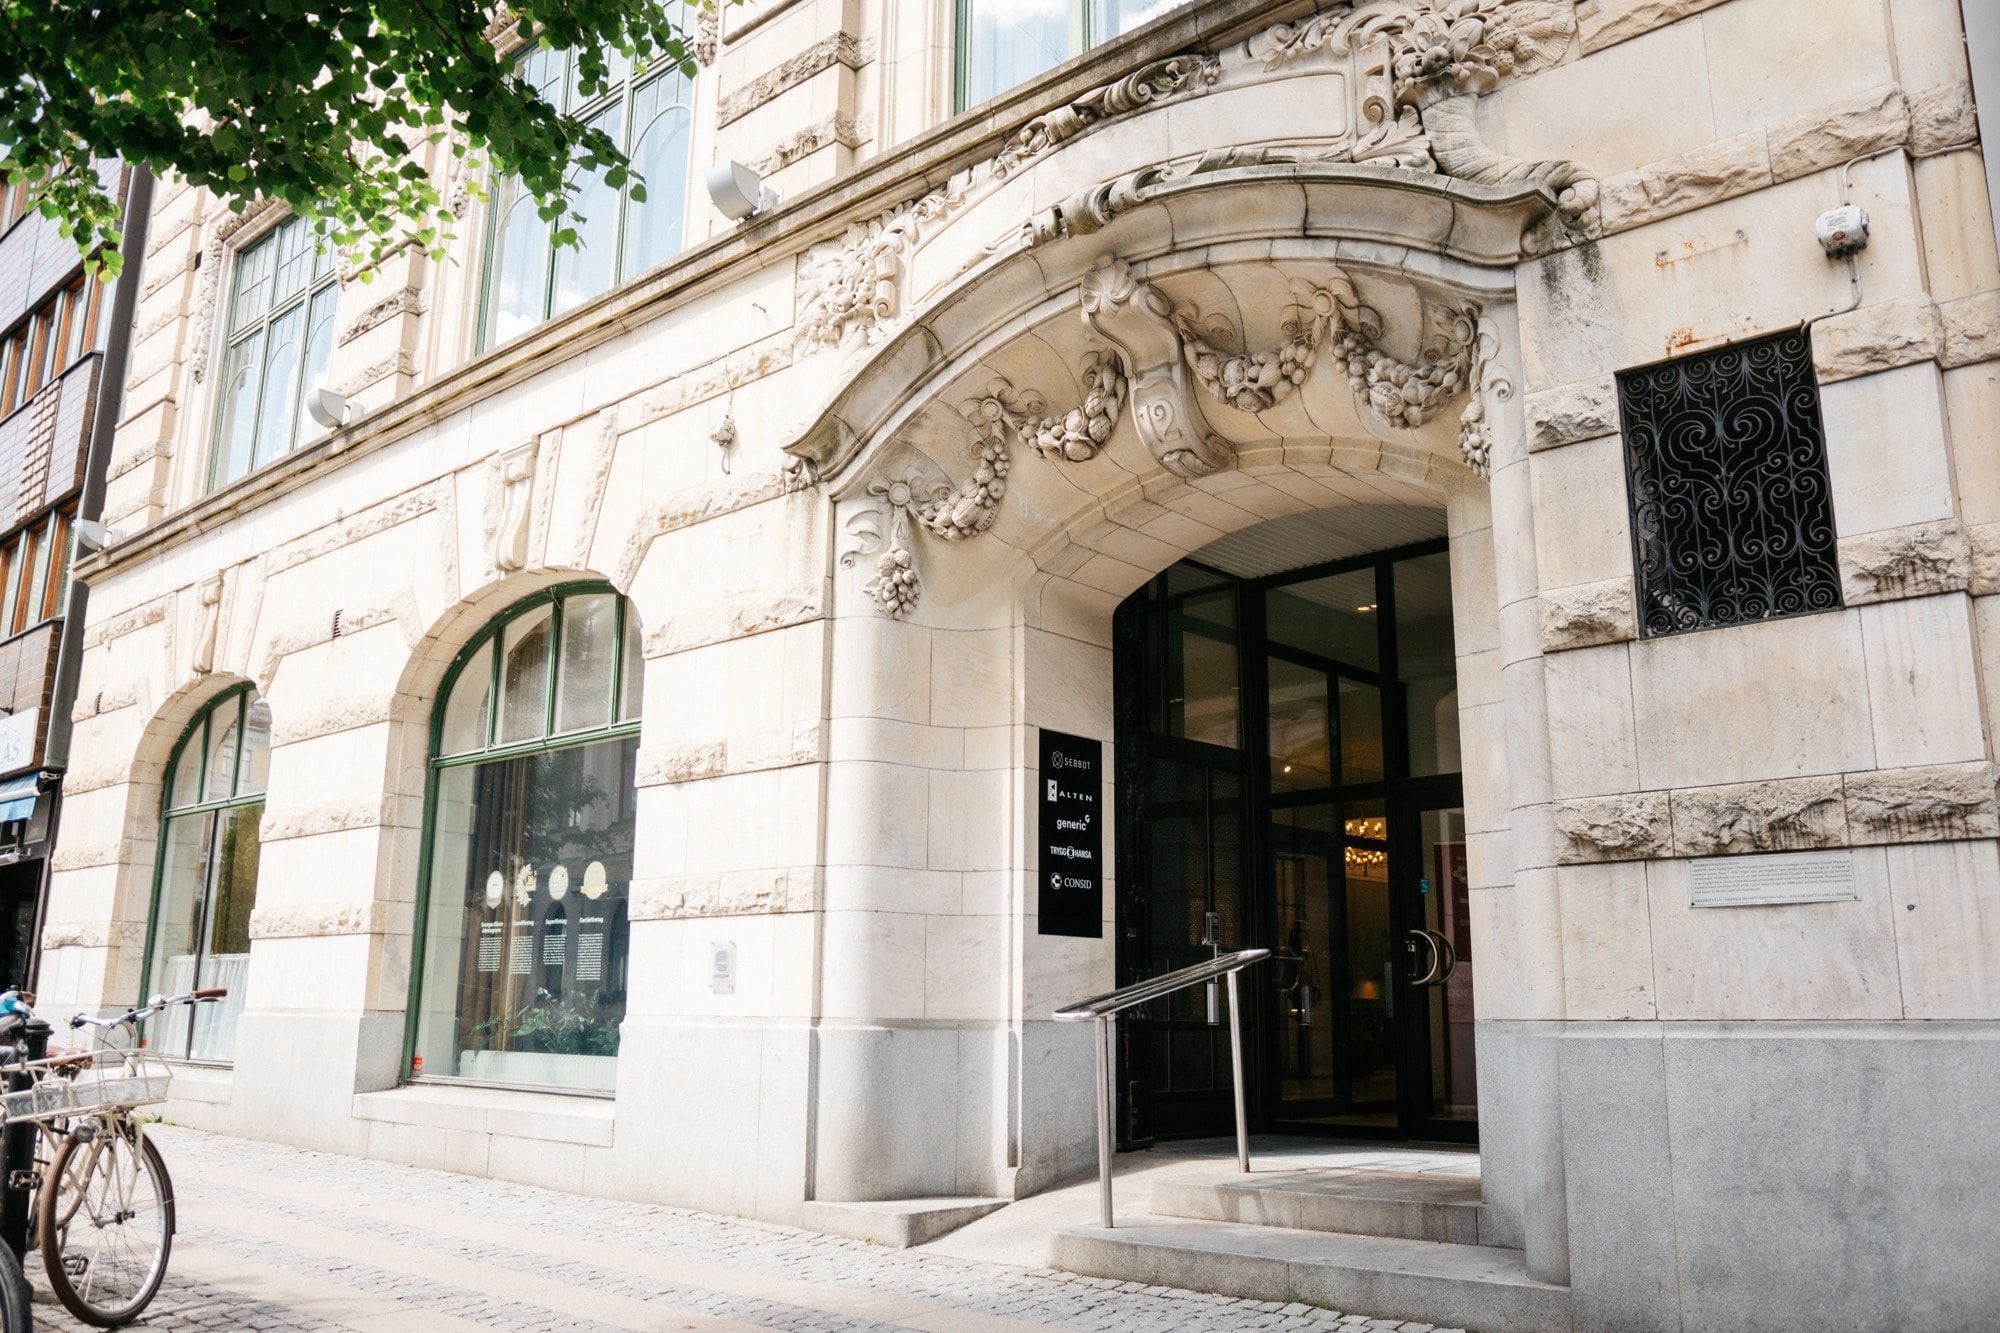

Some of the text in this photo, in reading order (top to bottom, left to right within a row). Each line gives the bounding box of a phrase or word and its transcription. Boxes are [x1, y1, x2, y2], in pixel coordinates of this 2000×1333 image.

[1137, 399, 1182, 444] 12
[1064, 757, 1091, 770] SEBBOT
[1059, 790, 1093, 802] ALTEN
[1056, 818, 1087, 831] generic
[1050, 845, 1092, 860] TRYGG HANSA
[1064, 877, 1092, 890] CONSID
